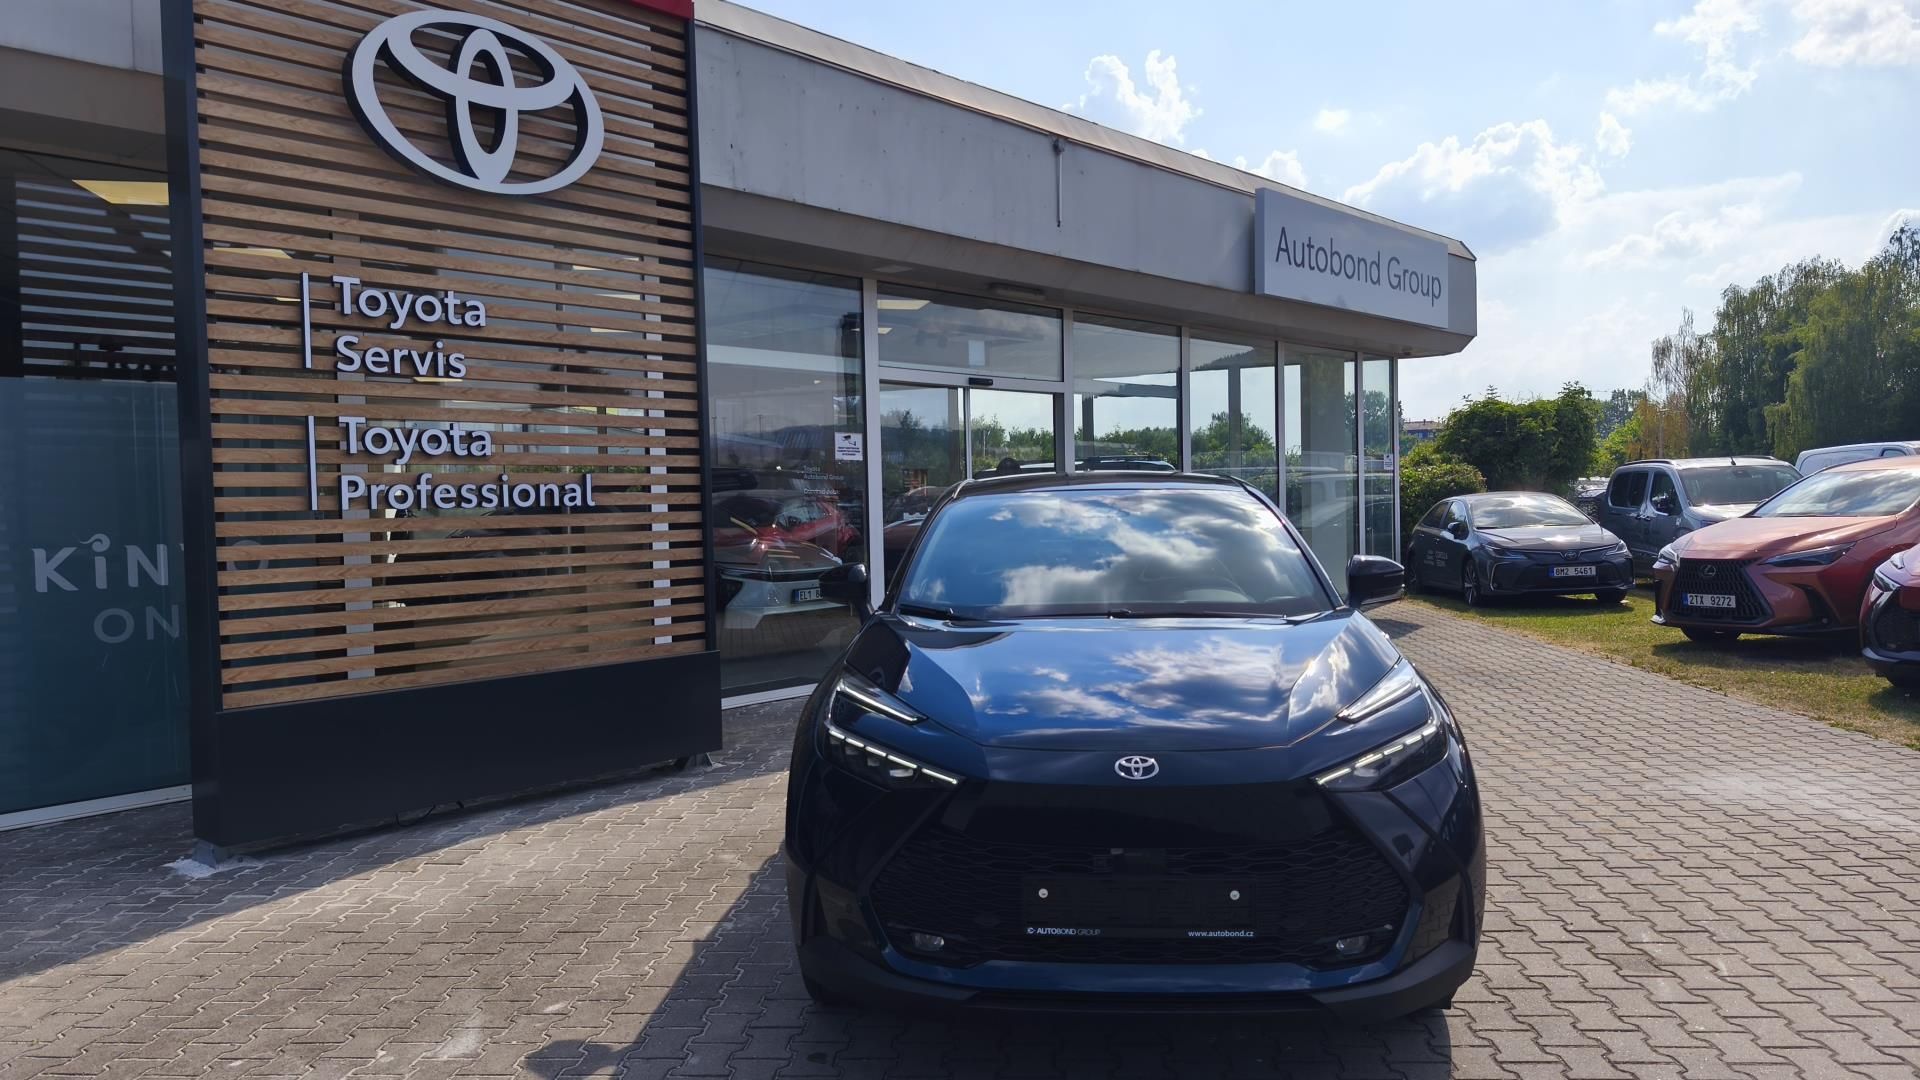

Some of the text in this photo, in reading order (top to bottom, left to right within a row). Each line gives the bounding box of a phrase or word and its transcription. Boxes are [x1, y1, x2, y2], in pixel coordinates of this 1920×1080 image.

[1275, 226, 1442, 308] Autobond Group
[332, 275, 487, 329] Toyota
[336, 335, 467, 378] Servis
[337, 416, 493, 465] Toyota
[340, 473, 596, 511] Professional
[1574, 567, 1593, 575] 5461
[1689, 595, 1732, 606] 2TX 9272
[1188, 929, 1254, 937] www.autobond.cz
